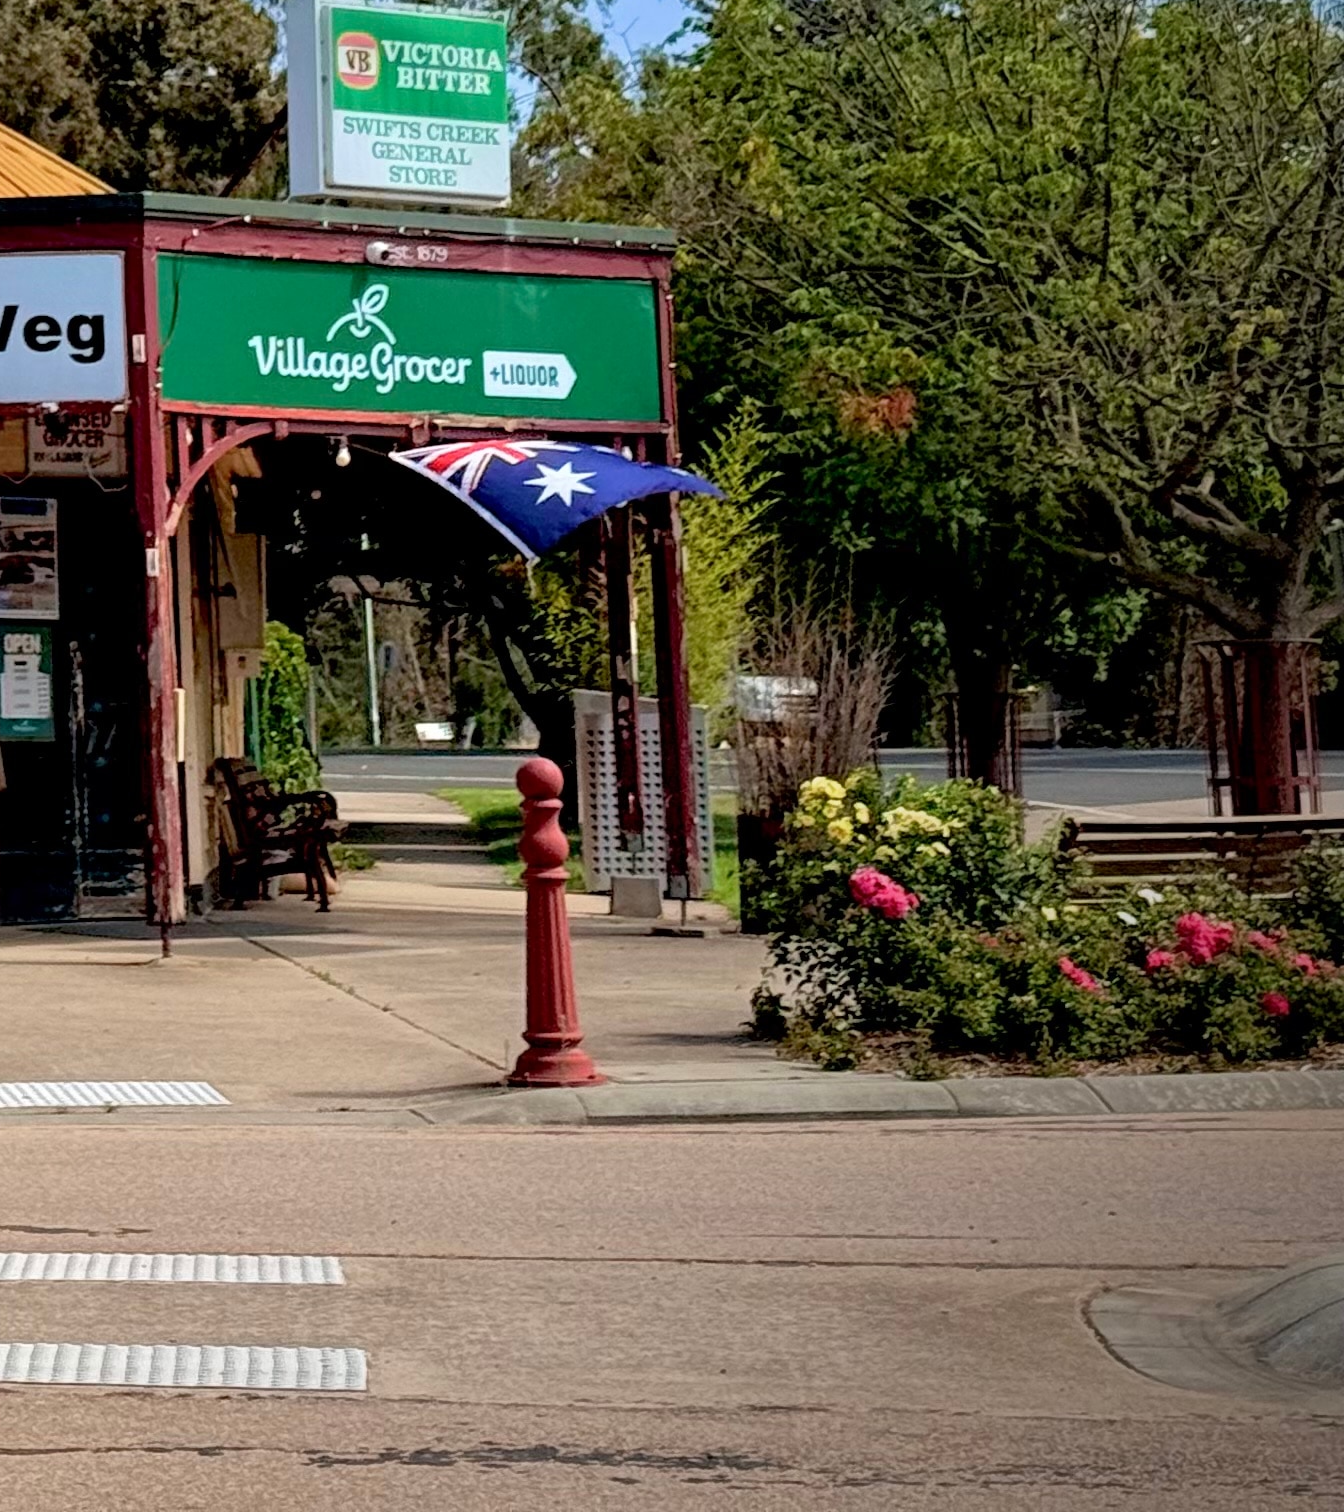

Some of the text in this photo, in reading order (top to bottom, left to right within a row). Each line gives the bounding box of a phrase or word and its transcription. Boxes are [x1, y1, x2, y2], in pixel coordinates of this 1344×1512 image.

[346, 49, 372, 74] VB
[381, 40, 504, 72] VICTORIA
[397, 66, 492, 95] BITTER
[343, 116, 500, 146] SWIFTS CREEK
[372, 141, 472, 166] GENERAL
[389, 165, 458, 187] STORE
[417, 245, 449, 263] 1879
[4, 632, 41, 654] OPEN
